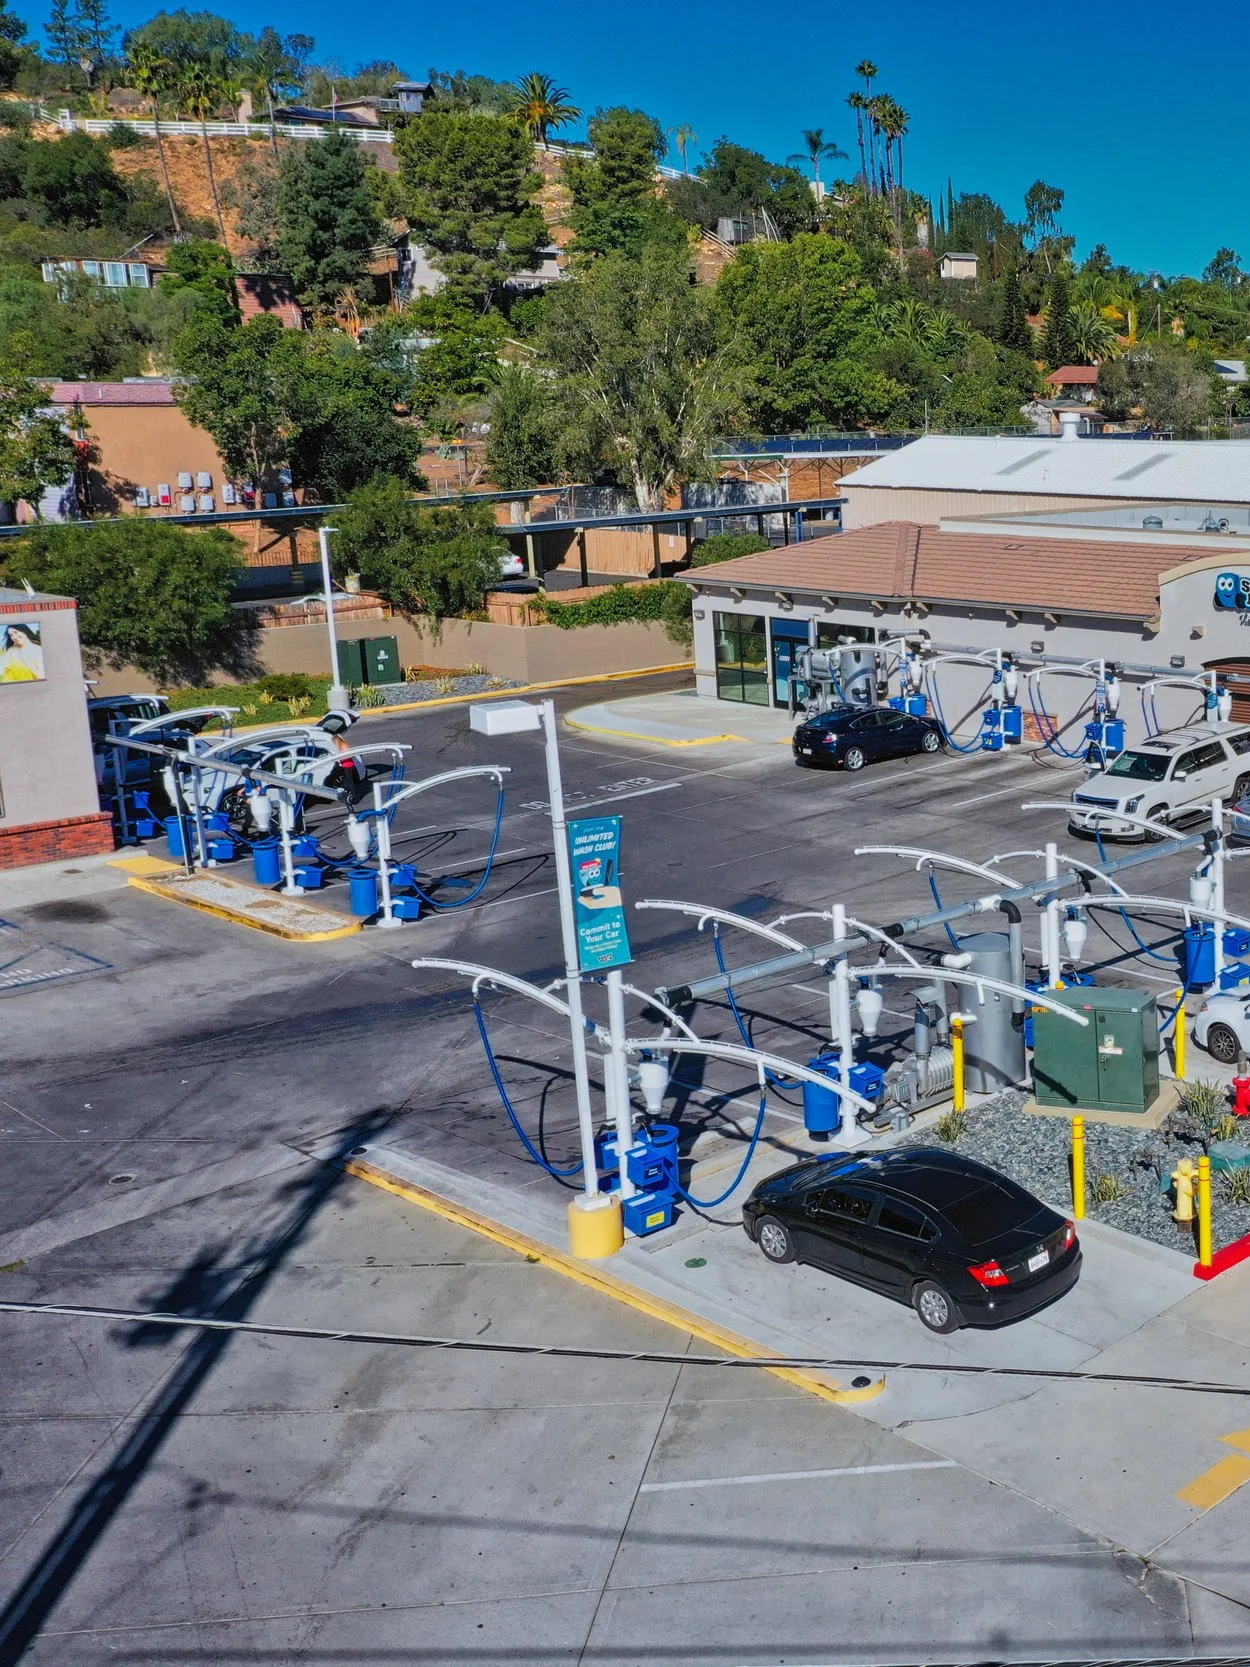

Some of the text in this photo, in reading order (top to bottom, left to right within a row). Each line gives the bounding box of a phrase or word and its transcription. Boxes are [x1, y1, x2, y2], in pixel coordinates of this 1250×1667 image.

[597, 777, 655, 792] ENTER
[575, 831, 614, 845] UNLIMITED
[573, 841, 617, 857] WASH CLUB!
[580, 921, 620, 936] Commit to
[585, 930, 620, 943] Your Car
